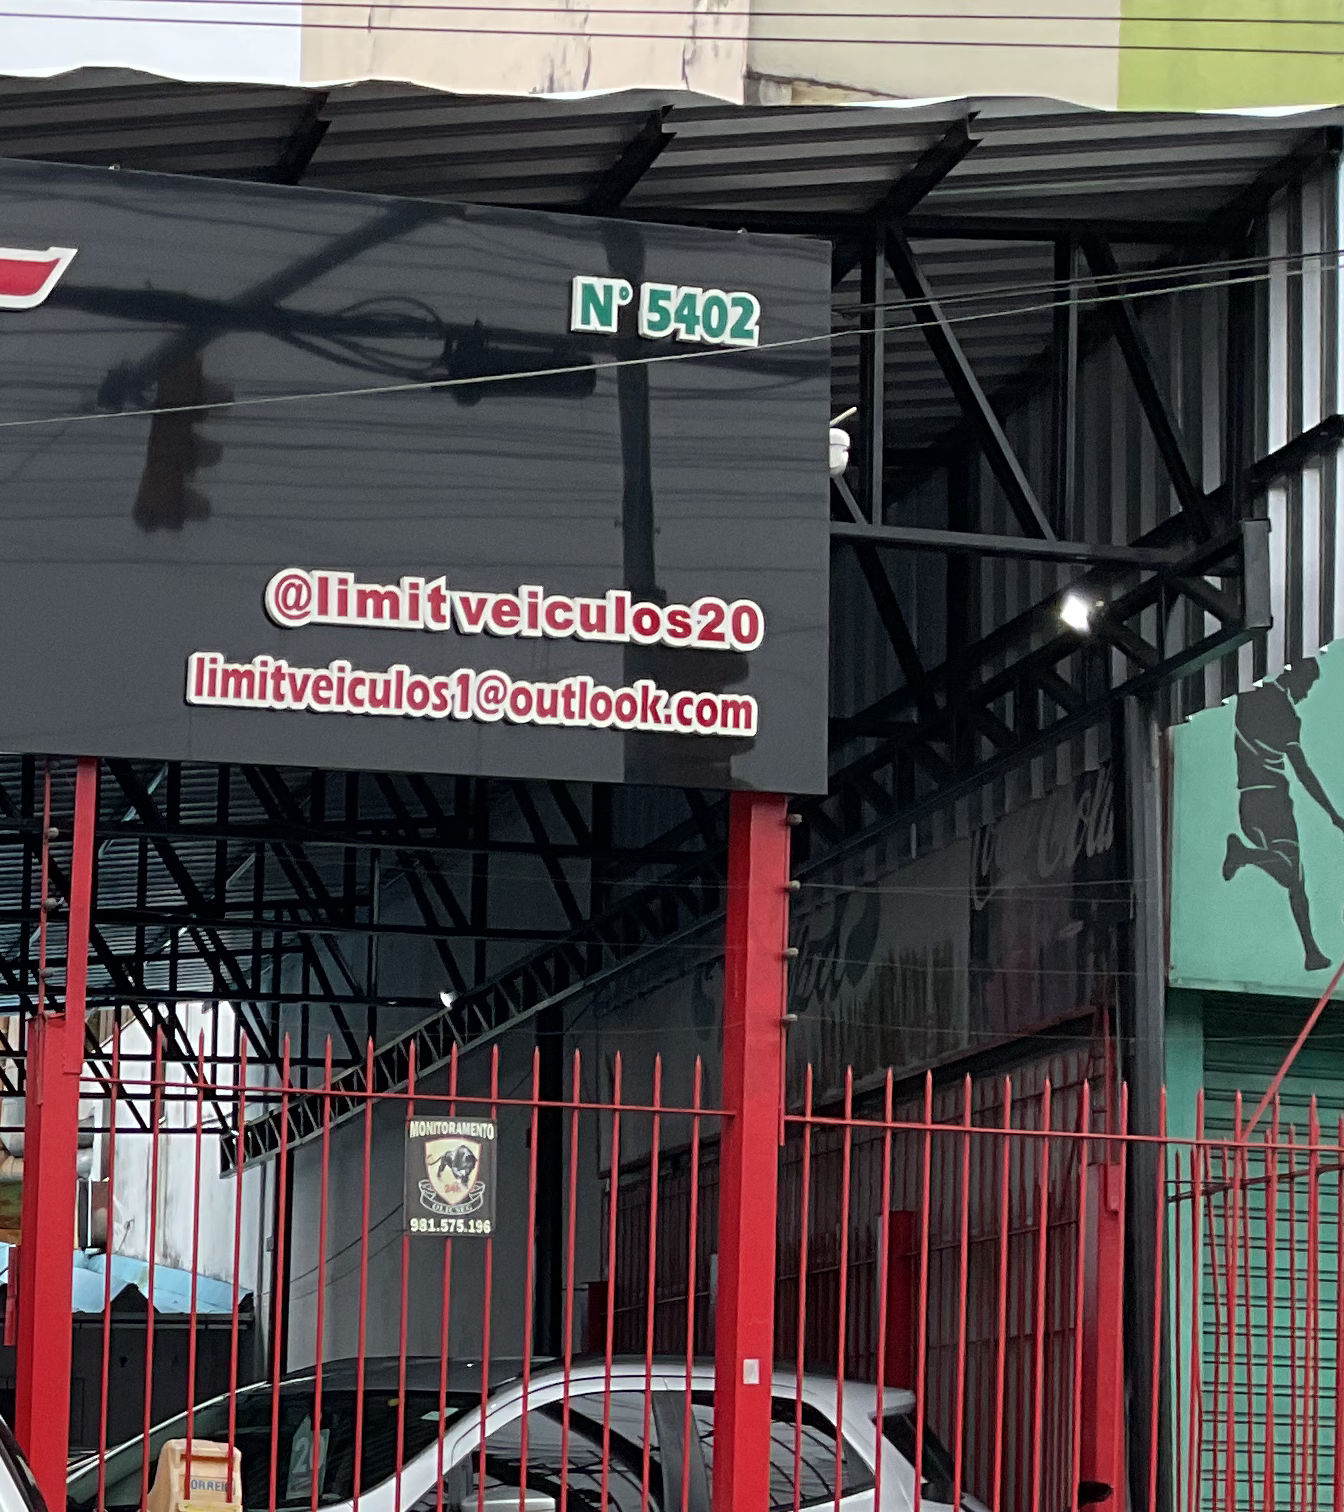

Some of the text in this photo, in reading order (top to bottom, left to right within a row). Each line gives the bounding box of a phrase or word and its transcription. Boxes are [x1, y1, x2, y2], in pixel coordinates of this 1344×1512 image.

[640, 283, 759, 346] 5402
[265, 567, 765, 651] @limitveiculos20
[187, 652, 758, 737] limitveiculos1@outlook.com
[409, 1121, 494, 1140] MONITORAMENTO
[410, 1218, 492, 1234] 981.575.196
